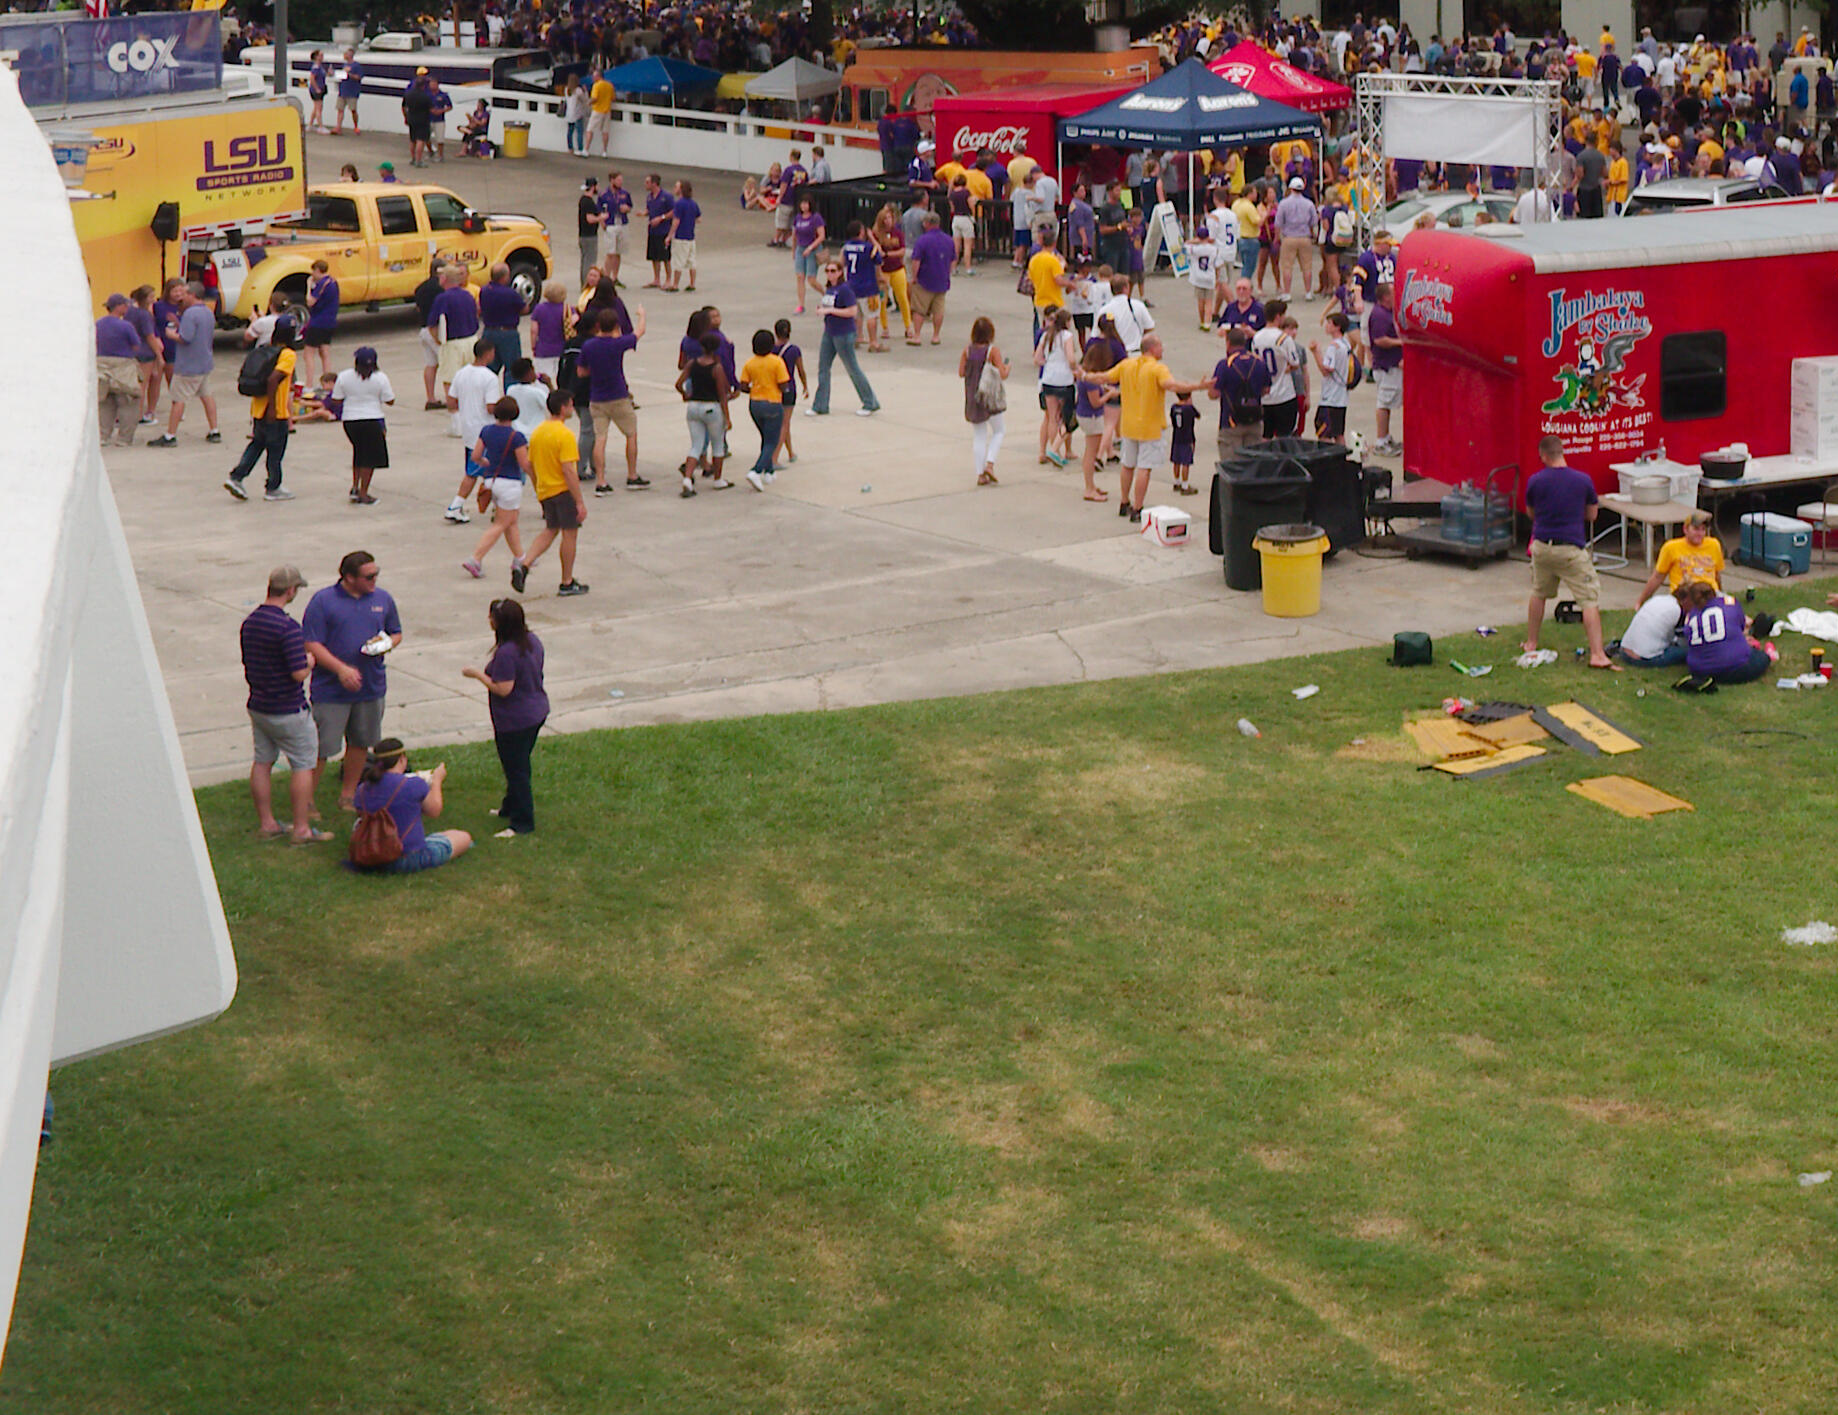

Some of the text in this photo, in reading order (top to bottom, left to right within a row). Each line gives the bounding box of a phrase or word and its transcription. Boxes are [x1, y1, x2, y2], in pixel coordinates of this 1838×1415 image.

[108, 34, 179, 74] COX
[204, 133, 286, 173] LSU
[205, 186, 287, 201] NETWORK
[206, 170, 285, 188] SPORTS RADIO
[1225, 224, 1234, 245] 5
[848, 253, 858, 274] 7
[1542, 288, 1645, 358] Jambalaya
[1594, 310, 1651, 344] Shake
[1689, 606, 1726, 645] 10
